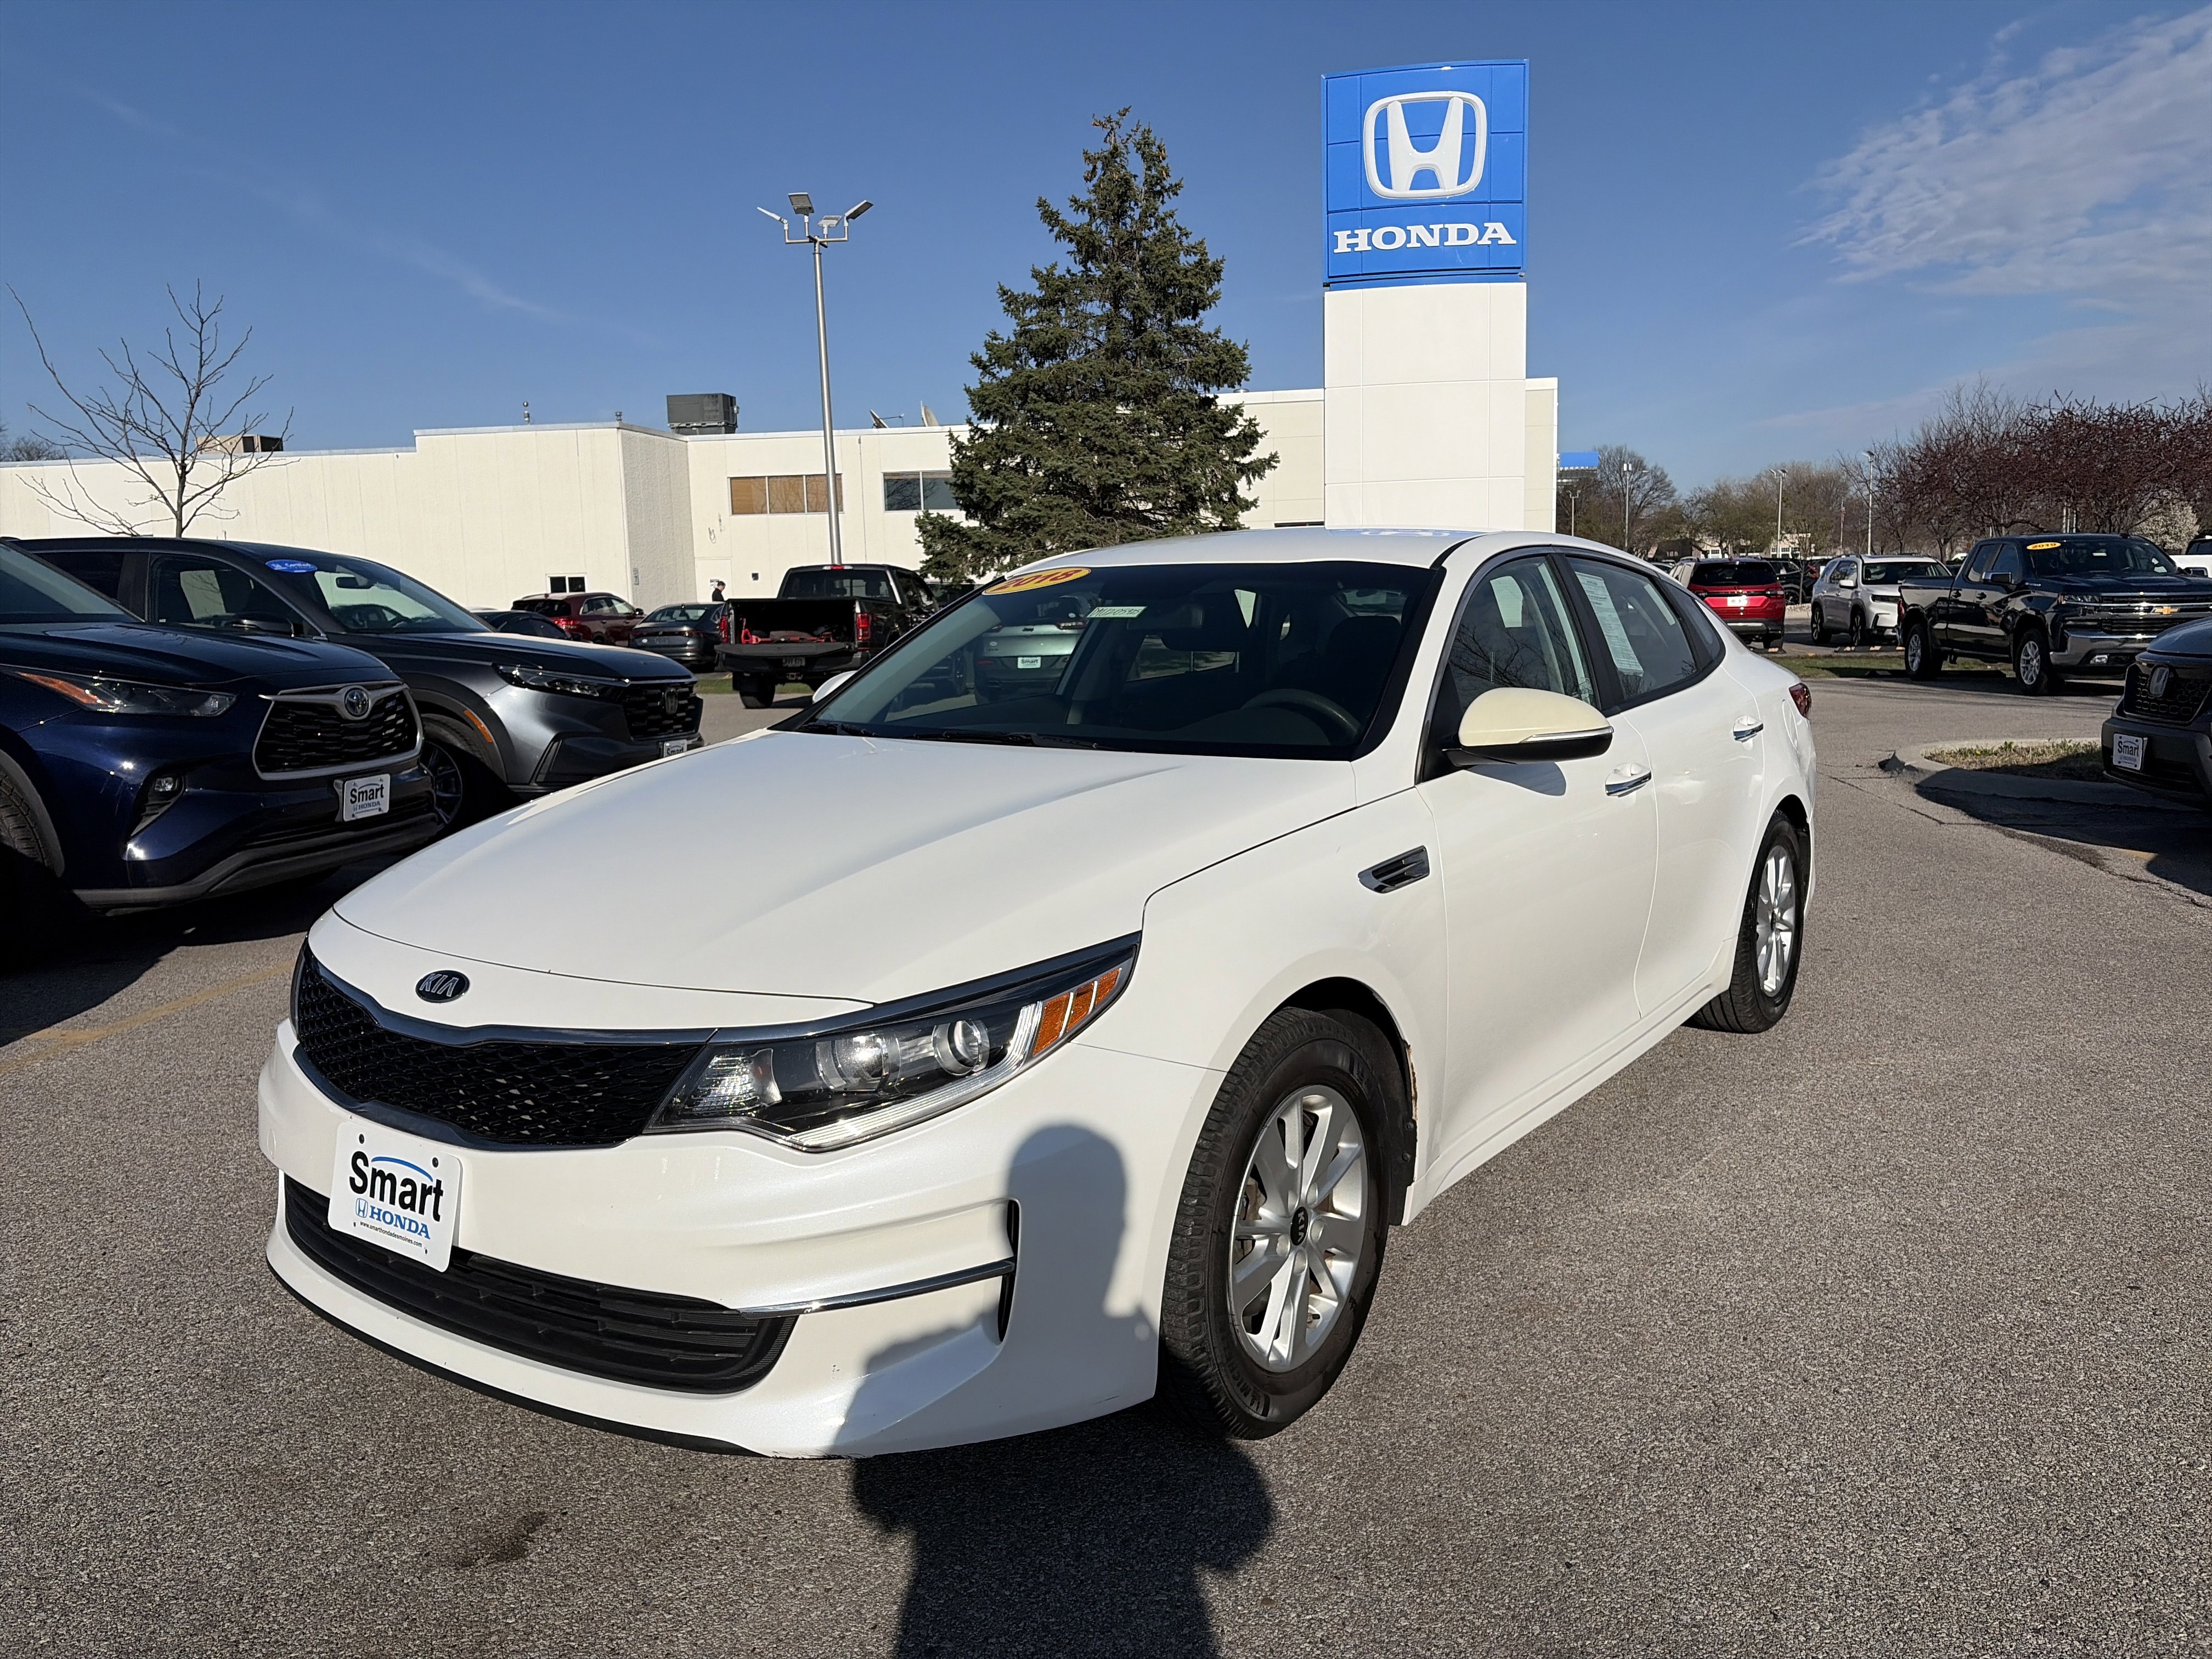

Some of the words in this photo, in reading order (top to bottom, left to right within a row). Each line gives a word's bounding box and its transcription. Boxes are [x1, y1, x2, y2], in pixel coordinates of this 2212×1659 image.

[1334, 222, 1516, 253] HONDA
[990, 569, 1083, 592] 2018
[2118, 741, 2139, 757] Smart
[350, 784, 384, 804] Smart
[359, 801, 380, 810] HONDA
[419, 973, 459, 997] KIA
[349, 1151, 443, 1222] Smart
[360, 1221, 422, 1248] www.smarthondadesmoines.com
[369, 1205, 431, 1240] HONDA
